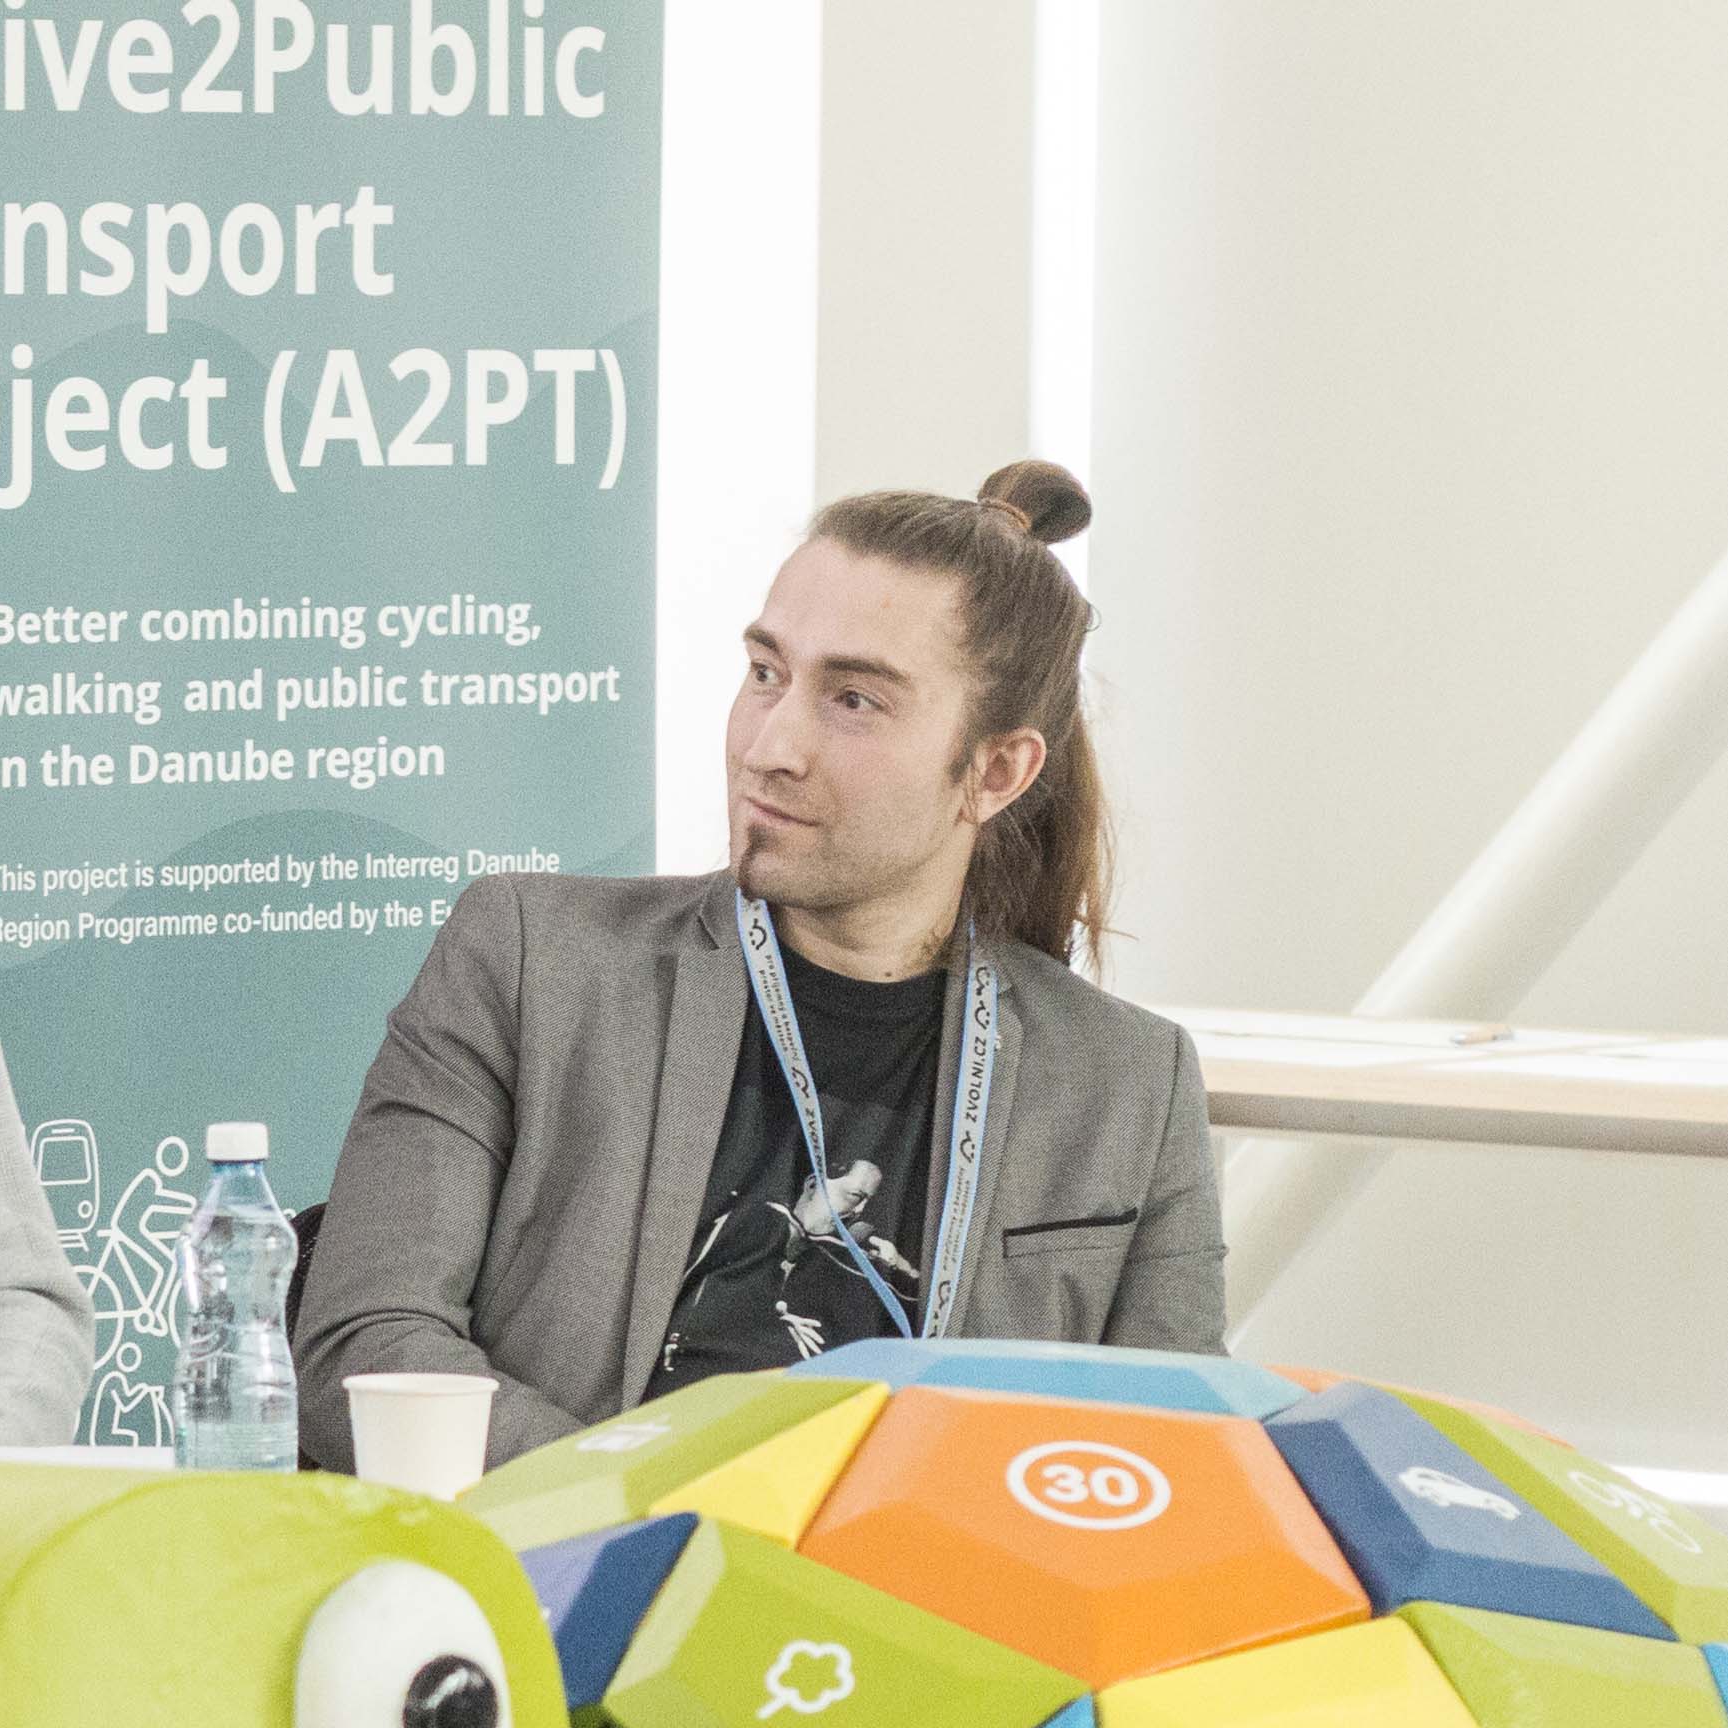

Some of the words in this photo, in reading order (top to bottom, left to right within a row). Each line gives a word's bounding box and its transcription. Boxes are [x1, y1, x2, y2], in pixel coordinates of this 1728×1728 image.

[263, 347, 627, 493] (A2PT)
[140, 597, 368, 649] combining
[377, 594, 541, 648] cycling,
[184, 668, 263, 712] and
[277, 666, 407, 722] public
[420, 665, 620, 716] transport
[40, 744, 115, 786] the
[129, 739, 294, 784] Danube
[307, 736, 444, 790] region
[43, 861, 128, 896] project
[135, 860, 155, 888] is
[160, 855, 280, 892] supported
[287, 854, 314, 888] by
[320, 853, 359, 880] the
[366, 851, 459, 883] Interreg
[467, 847, 560, 876] Danube
[78, 912, 217, 944] Programme
[223, 902, 343, 935] co-funded
[349, 900, 378, 935] by
[383, 900, 423, 927] the
[965, 1036, 987, 1123] ZVOLNI.CZ
[1042, 1464, 1140, 1507] 30
